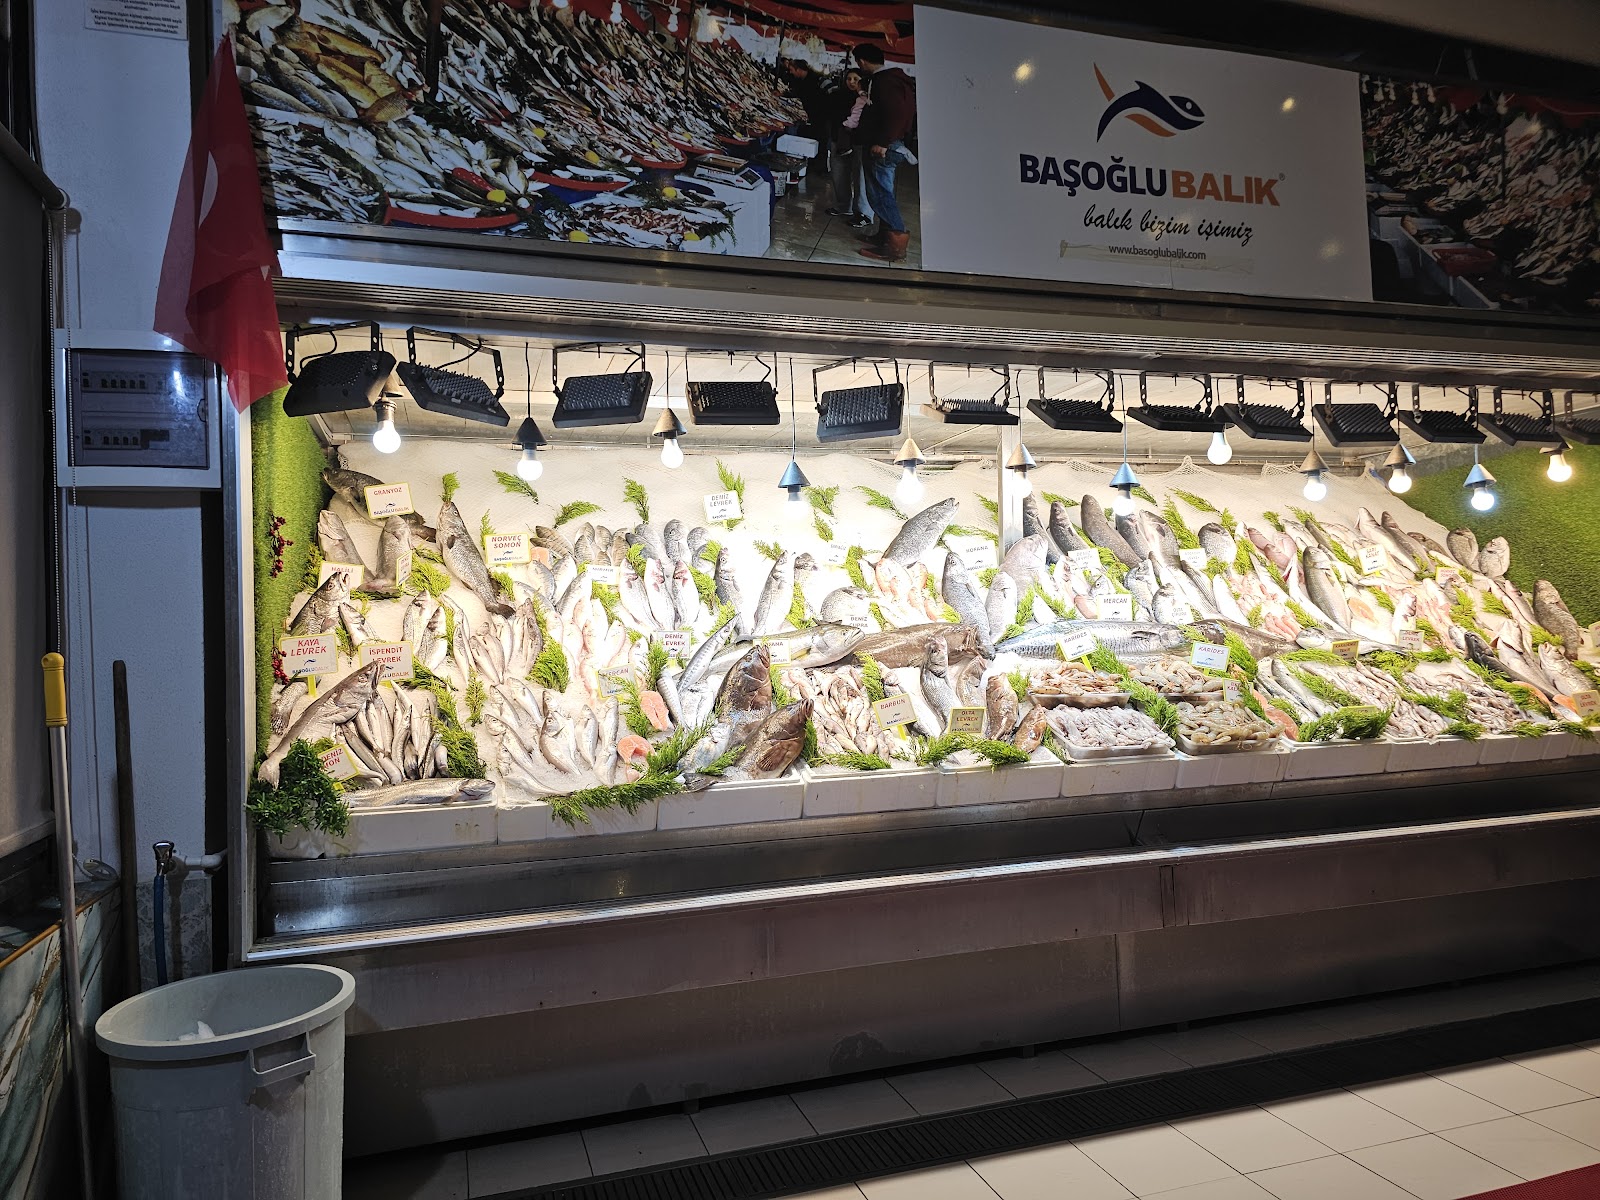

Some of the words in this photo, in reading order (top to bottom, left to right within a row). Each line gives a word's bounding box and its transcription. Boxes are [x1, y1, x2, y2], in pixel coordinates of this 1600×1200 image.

[1083, 203, 1133, 231] balık
[1139, 210, 1190, 242] bizim
[1197, 218, 1254, 247] işimiz
[1108, 244, 1207, 260] www.basoglubalik.com
[373, 487, 403, 496] GRANYOZ
[493, 541, 522, 549] SOMON
[297, 638, 320, 647] KAYA
[290, 645, 328, 657] LEVREK
[369, 646, 403, 656] İSPENDİT
[1198, 645, 1225, 655] KARİDES
[880, 698, 906, 710] BARBUN
